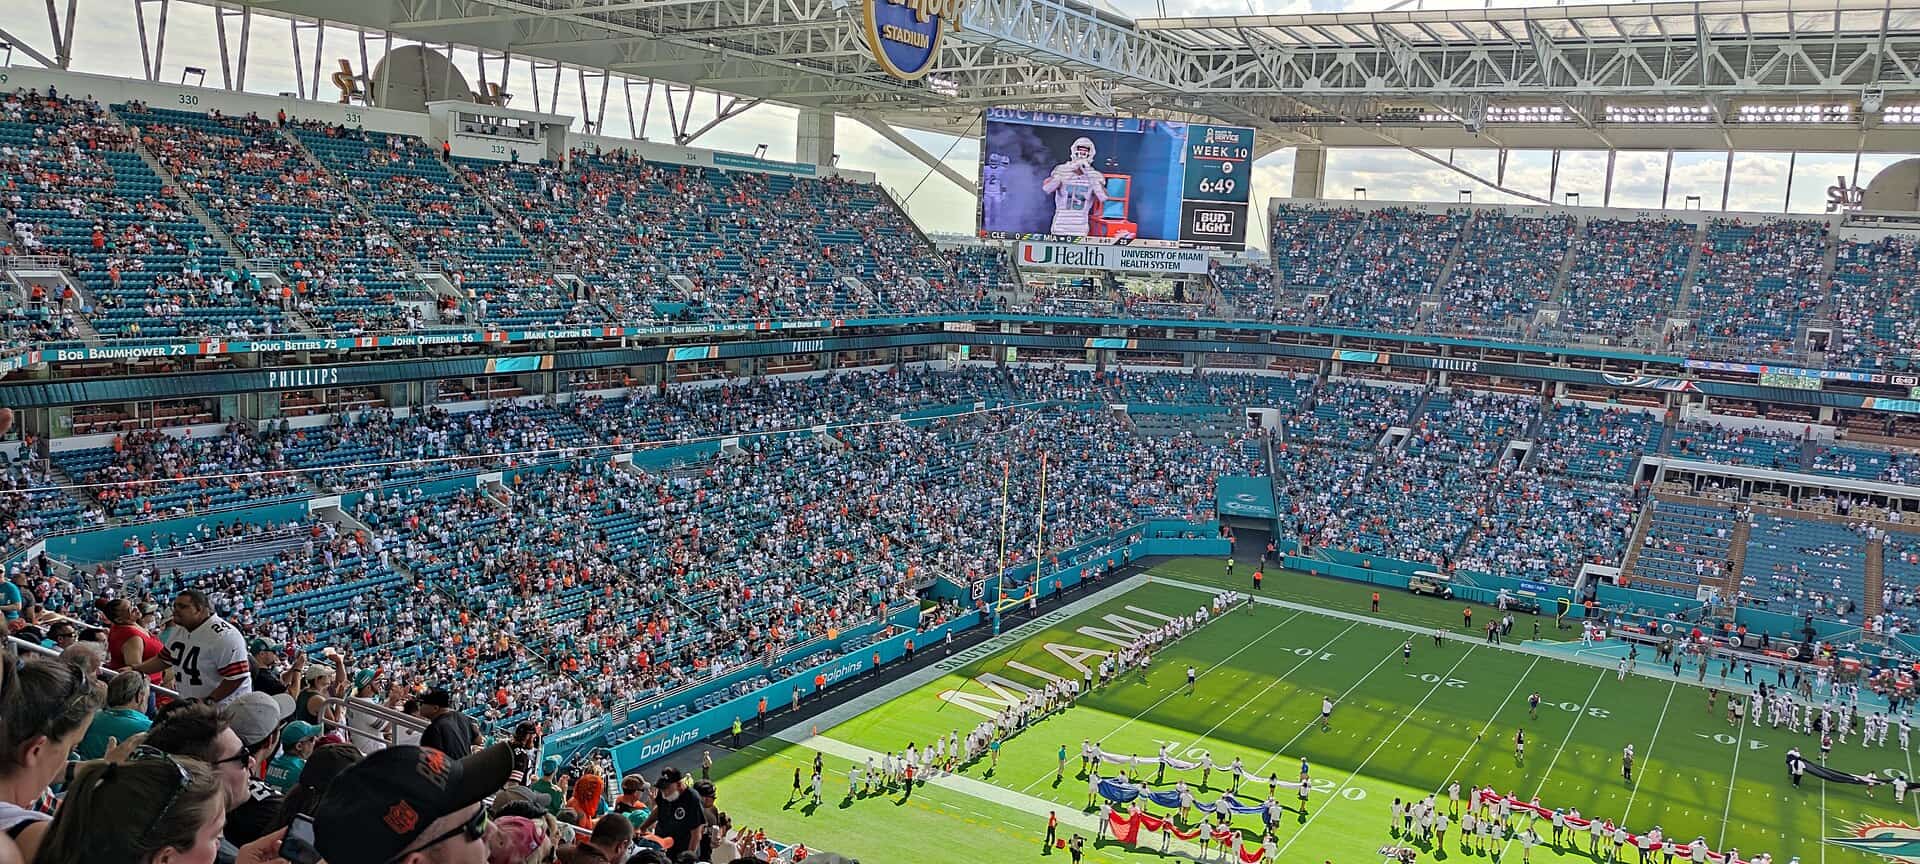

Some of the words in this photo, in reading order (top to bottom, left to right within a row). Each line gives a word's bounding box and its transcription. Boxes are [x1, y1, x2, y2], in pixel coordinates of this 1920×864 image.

[883, 24, 929, 48] STADIUM
[178, 94, 199, 105] 330
[345, 113, 361, 123] 331
[1032, 112, 1125, 128] MORTGAGE
[491, 144, 505, 154] 332
[1193, 145, 1229, 157] WEEK
[1234, 148, 1248, 158] 10
[1200, 177, 1235, 194] 6:49
[1066, 184, 1089, 210] 15
[1200, 212, 1227, 223] BUD
[1195, 222, 1231, 233] LIGHT
[991, 231, 1006, 239] CLE
[1044, 234, 1058, 242] MIA
[1121, 250, 1166, 260] UNIVERSITY
[1166, 252, 1177, 260] OF
[1177, 253, 1204, 262] MIAMI
[1120, 259, 1150, 269] HEALTH
[1150, 261, 1181, 270] SYSTEM
[391, 337, 415, 346] JOHN
[417, 335, 460, 345] OFFERDAHL
[462, 334, 474, 343] 56
[524, 331, 546, 340] MARK
[547, 329, 580, 339] CLAYTON
[581, 328, 592, 338] 83
[58, 349, 84, 361] BOB
[89, 346, 166, 360] BAUMHOWER
[170, 344, 187, 356] 73
[250, 341, 281, 352] DOUG
[284, 340, 321, 351] BETTERS
[324, 339, 337, 349] 75
[793, 339, 824, 353] PHILLIPS
[1432, 358, 1478, 372] PHILLIPS
[269, 367, 338, 388] PHILLIPS
[973, 582, 984, 597] 25
[210, 621, 232, 633] 24
[935, 640, 998, 672] SALUTE
[1016, 610, 1071, 640] SERVICE
[170, 640, 203, 686] 24
[937, 604, 1178, 721] MIAMI
[640, 727, 700, 761] Dolphins
[1309, 778, 1368, 801] 20
